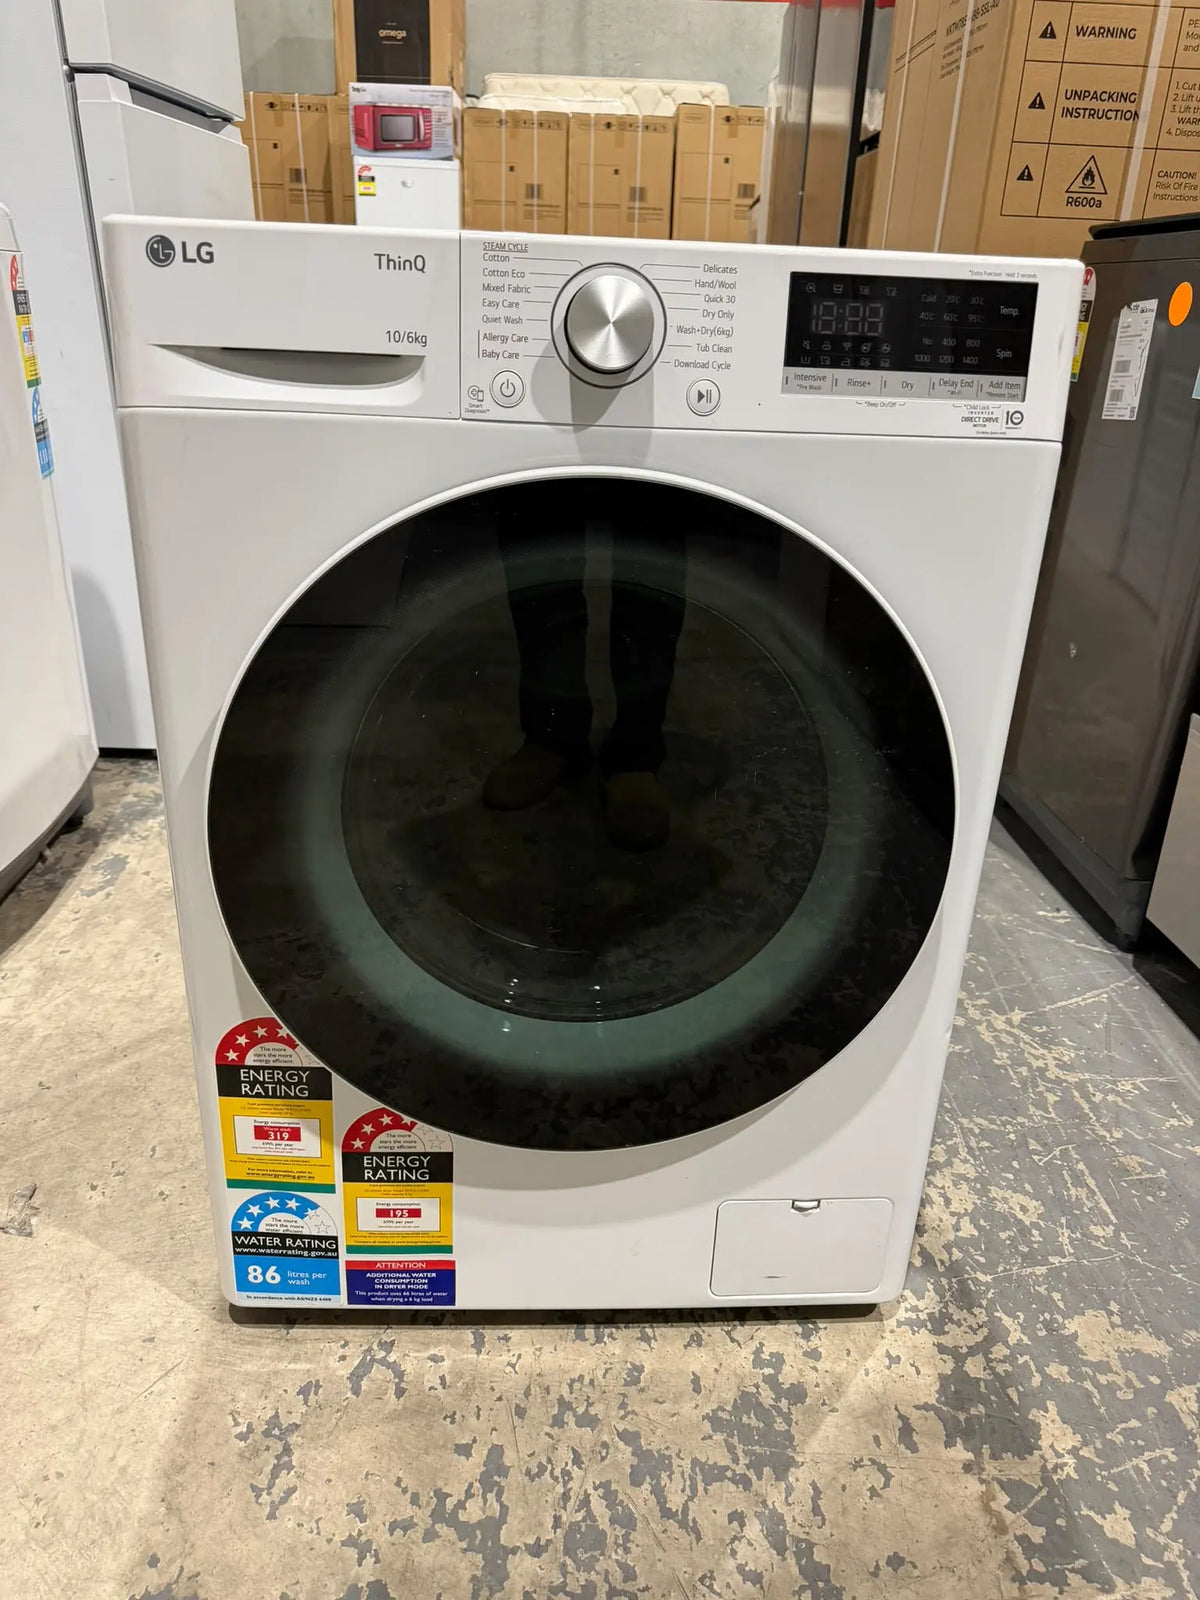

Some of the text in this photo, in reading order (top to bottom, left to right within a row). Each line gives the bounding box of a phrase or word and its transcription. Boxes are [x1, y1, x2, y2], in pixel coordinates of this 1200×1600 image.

[378, 29, 407, 39] omega
[1075, 25, 1137, 40] WARNING
[1183, 44, 1200, 52] and
[1182, 81, 1197, 91] Cut
[1064, 89, 1138, 104] UNPACKING
[1181, 93, 1194, 102] Lift
[1061, 106, 1140, 122] INSTRUCTION
[1179, 104, 1192, 114] Lift
[1157, 170, 1197, 180] CAUTION!
[1155, 181, 1199, 191] Risk Of Fire
[1066, 196, 1102, 209] R600a
[1153, 192, 1199, 202] Instructions
[482, 241, 529, 252] STEAM CYCLE
[181, 241, 215, 264] LG
[482, 252, 510, 262] Cotton
[374, 253, 426, 273] ThinQ
[482, 267, 526, 278] Cotton Eco
[703, 264, 738, 274] Delicates
[482, 283, 531, 294] Mixed Fabric
[694, 279, 737, 290] Hand/Wool
[482, 298, 520, 309] Easy Care
[704, 294, 736, 304] Quick 30
[702, 309, 735, 321] Dry Only
[999, 305, 1020, 317] Temp.
[481, 314, 523, 325] Quiet Wash
[676, 325, 734, 338] Wash+Dry(6kg)
[385, 330, 428, 347] 10/6kg
[482, 333, 529, 344] Allergy Care
[942, 337, 980, 348] 400 800
[696, 343, 733, 353] Tub Clean
[481, 349, 520, 360] Baby Care
[915, 354, 979, 365] 1000 1200 1400
[996, 348, 1012, 360] Spin
[674, 359, 731, 371] Download Cycle
[794, 372, 827, 382] Intensive
[847, 378, 871, 388] Rinse+
[901, 380, 915, 392] Dry
[939, 378, 974, 389] Delay End
[988, 381, 1021, 391] Add Item
[1005, 410, 1024, 426] 10
[240, 1069, 310, 1083] ENERGY
[241, 1083, 309, 1097] RATING
[268, 1131, 290, 1140] 319
[363, 1155, 431, 1168] ENERGY
[364, 1169, 430, 1181] RATING
[389, 1209, 409, 1218] 195
[234, 1235, 337, 1249] WATER RATING
[234, 1247, 338, 1257] www.waterrating.gov.au
[247, 1265, 281, 1284] 86
[287, 1270, 327, 1282] litres per
[287, 1278, 310, 1286] wash
